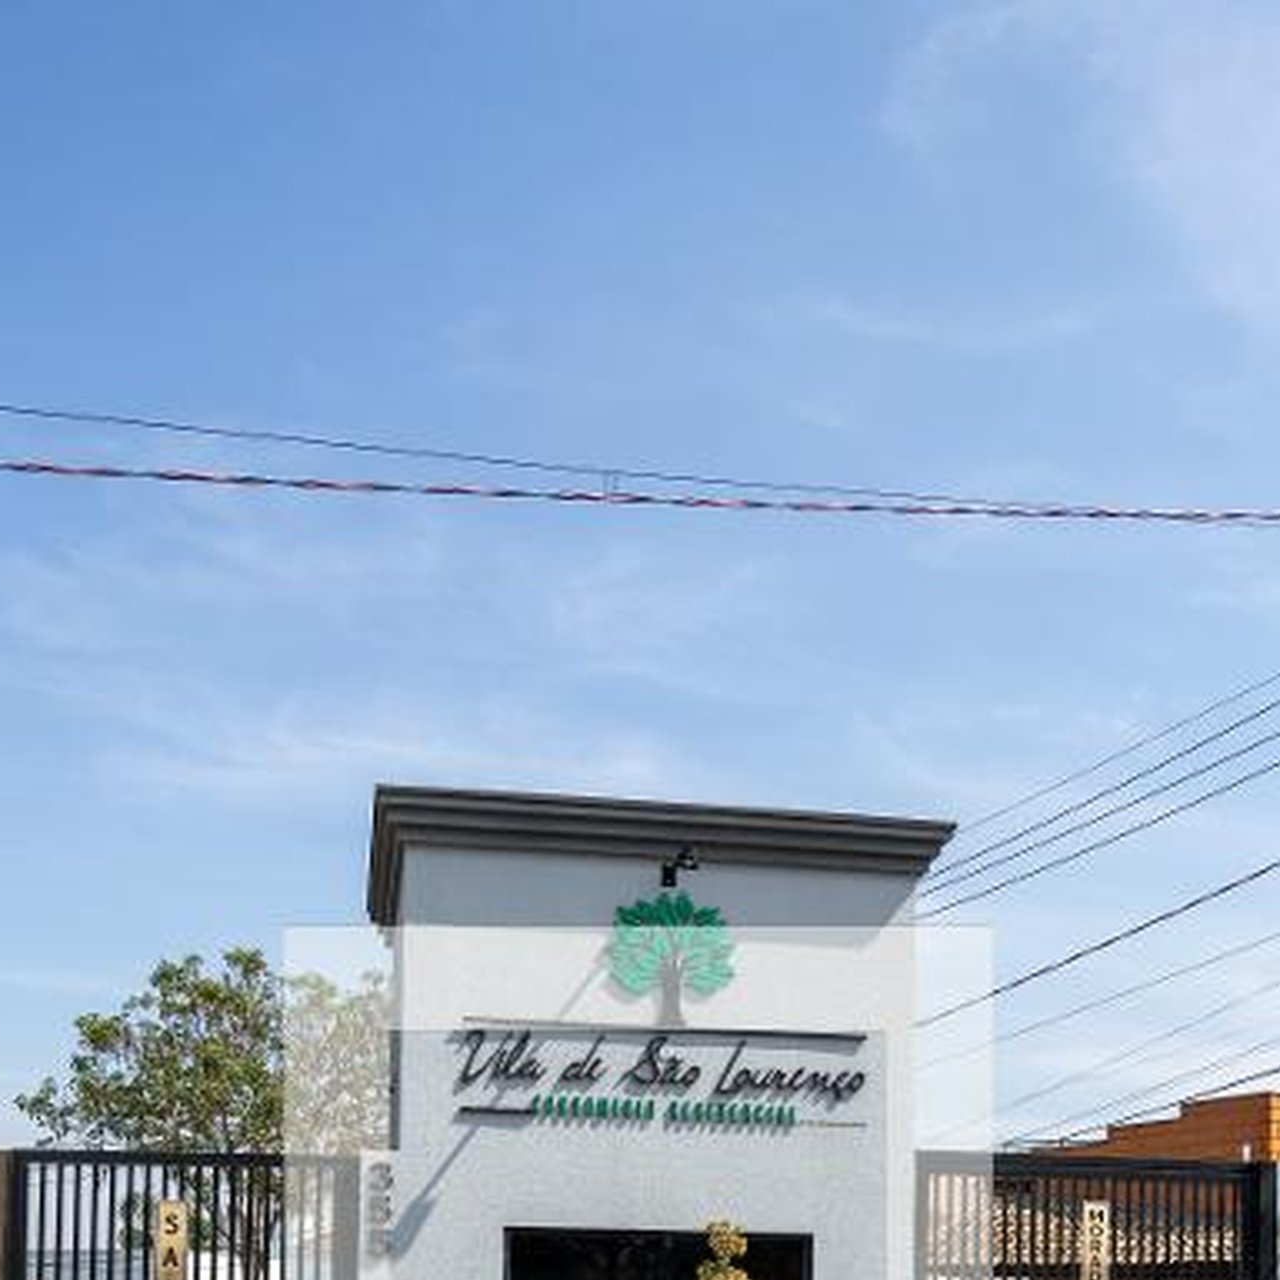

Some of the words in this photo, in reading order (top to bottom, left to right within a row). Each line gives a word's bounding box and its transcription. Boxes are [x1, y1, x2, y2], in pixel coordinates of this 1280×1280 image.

[460, 1029, 547, 1088] Vila
[561, 1036, 607, 1081] de
[614, 1036, 701, 1088] São
[714, 1040, 865, 1101] Lourenço
